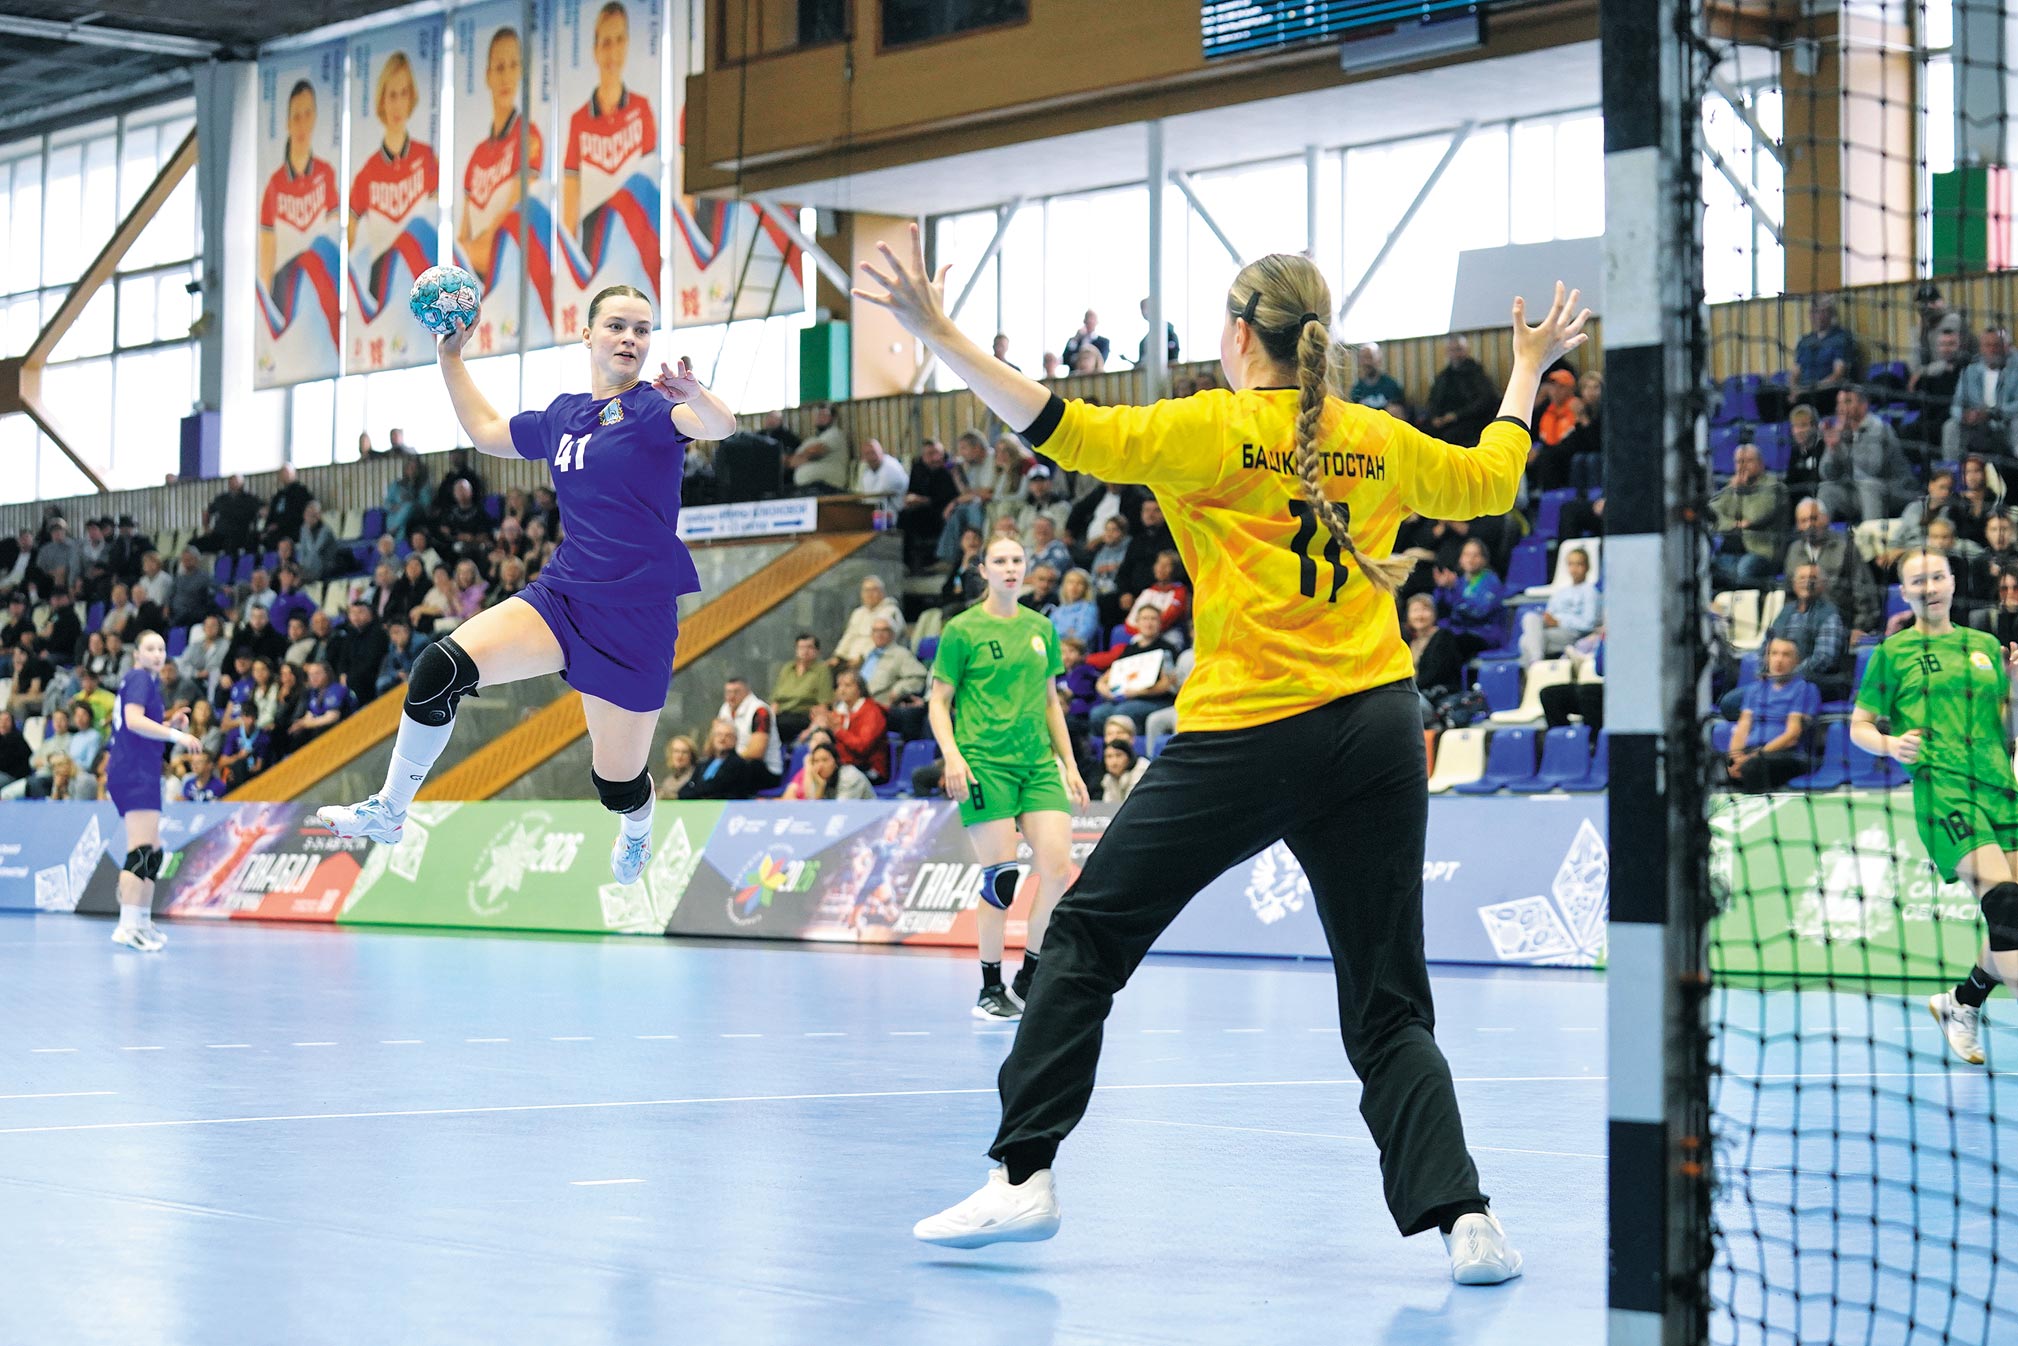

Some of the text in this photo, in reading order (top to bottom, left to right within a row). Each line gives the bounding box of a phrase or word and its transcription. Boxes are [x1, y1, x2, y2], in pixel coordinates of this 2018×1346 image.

[554, 433, 592, 473] 41
[1242, 443, 1385, 480] БАШКТОСТАН
[988, 640, 1004, 660] 8
[1916, 653, 1942, 675] 18
[970, 783, 985, 811] 8
[1939, 809, 1974, 846] 18
